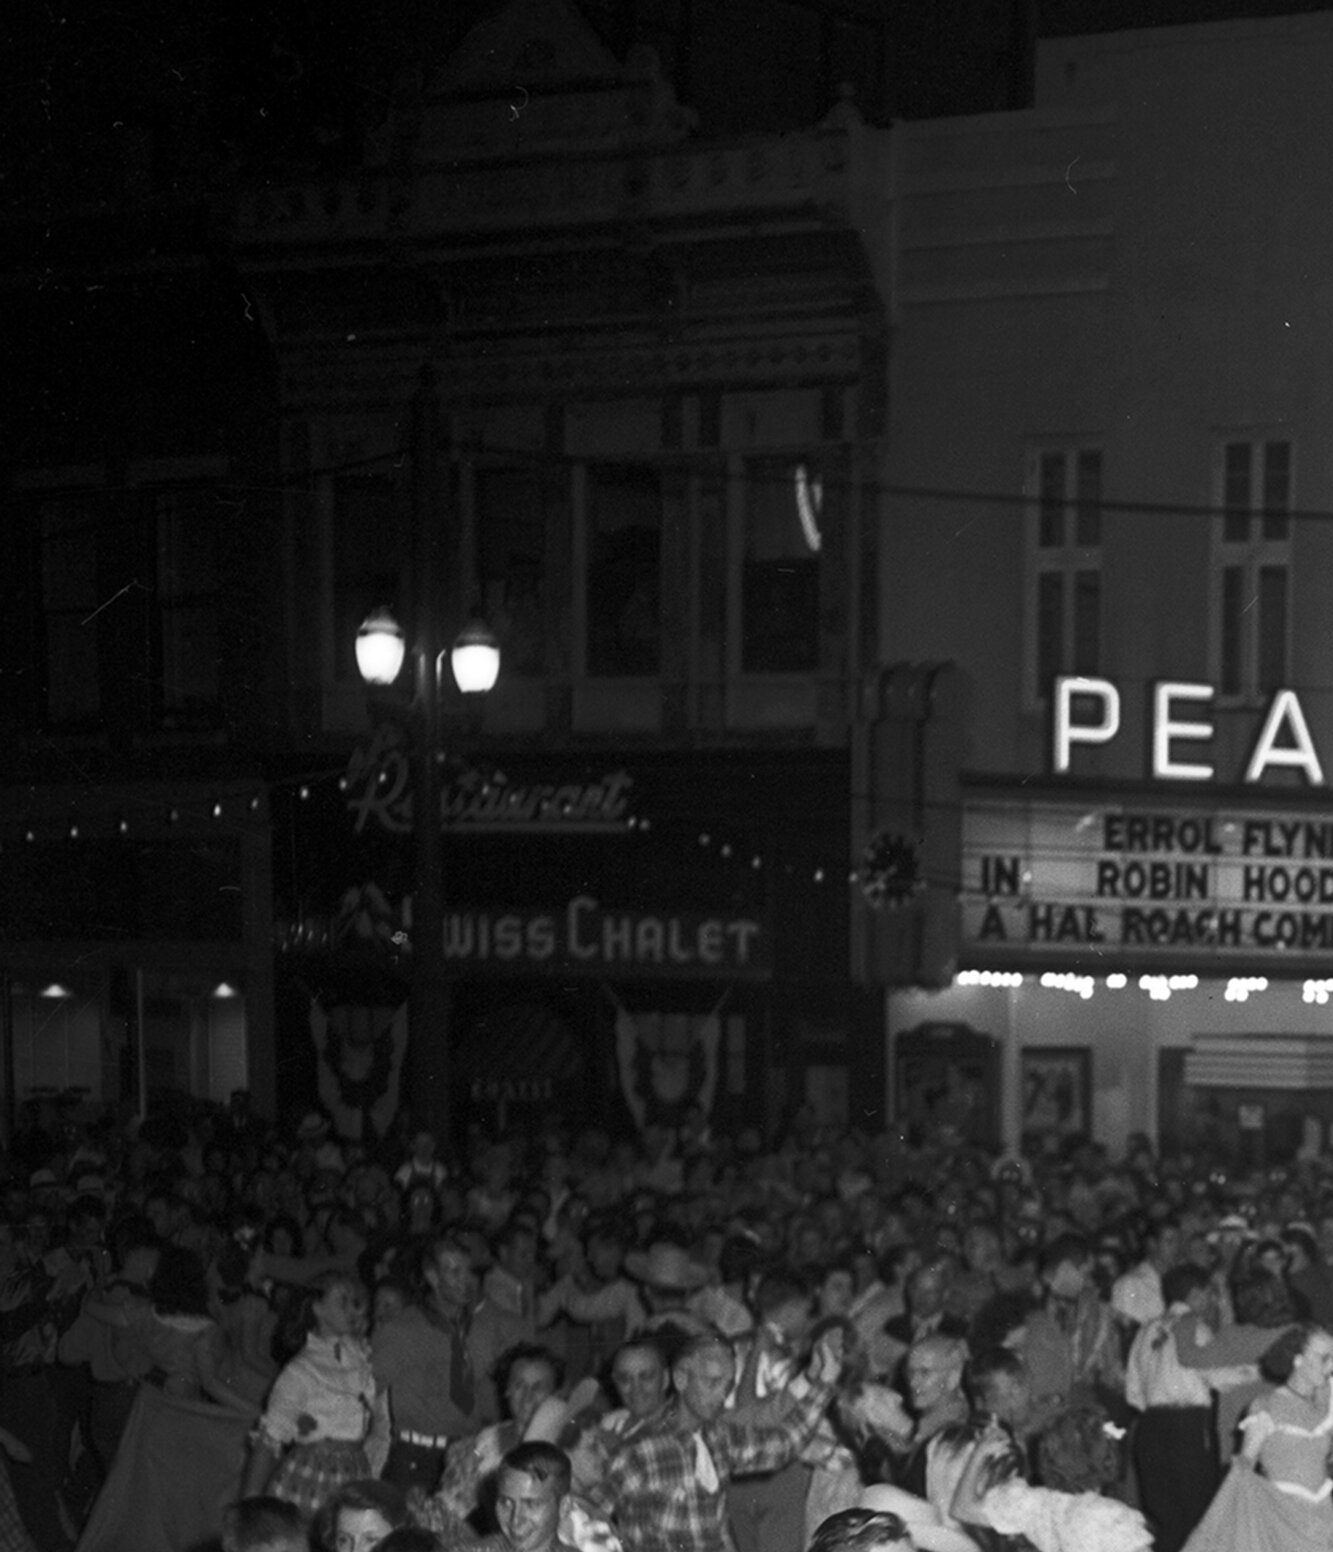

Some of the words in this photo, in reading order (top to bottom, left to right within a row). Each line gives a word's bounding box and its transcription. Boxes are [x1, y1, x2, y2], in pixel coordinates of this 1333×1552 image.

[1104, 816, 1223, 853] ERROL
[982, 857, 1019, 896] IN
[1098, 861, 1208, 898] ROBIN
[402, 895, 554, 959] WISS
[980, 905, 1008, 941] A
[1029, 904, 1106, 942] HAL
[1121, 907, 1242, 946] ROACH
